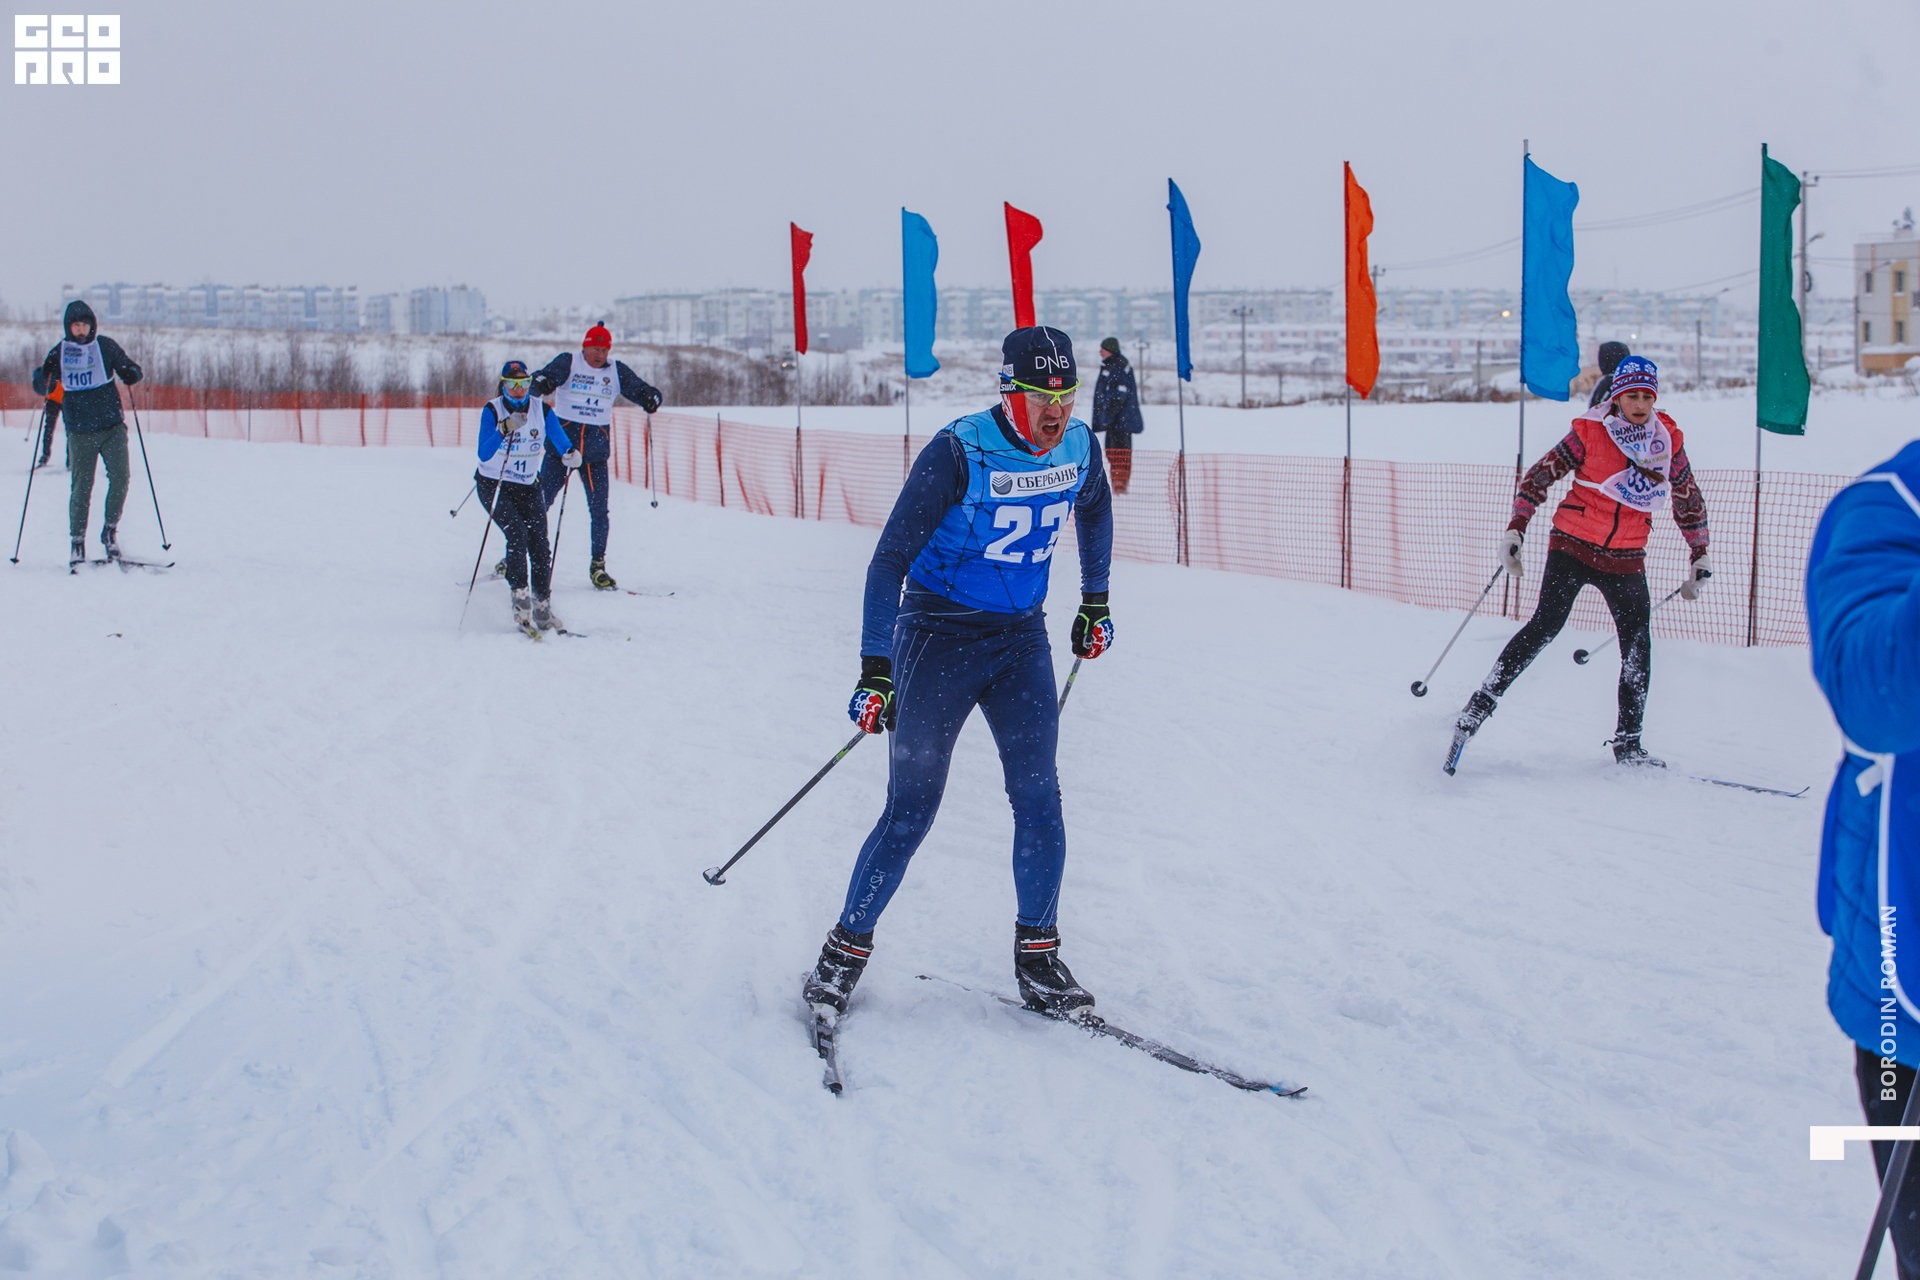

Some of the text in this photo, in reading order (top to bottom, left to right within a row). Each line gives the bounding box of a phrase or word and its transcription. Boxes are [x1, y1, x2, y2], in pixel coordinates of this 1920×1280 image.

[1035, 355, 1070, 374] DNB
[67, 371, 92, 386] 1107
[1616, 431, 1647, 445] ОССИИ
[514, 460, 526, 473] 11
[1017, 467, 1077, 488] СБЕРБАНК
[984, 500, 1069, 564] 23
[1028, 941, 1054, 949] ATOMIC
